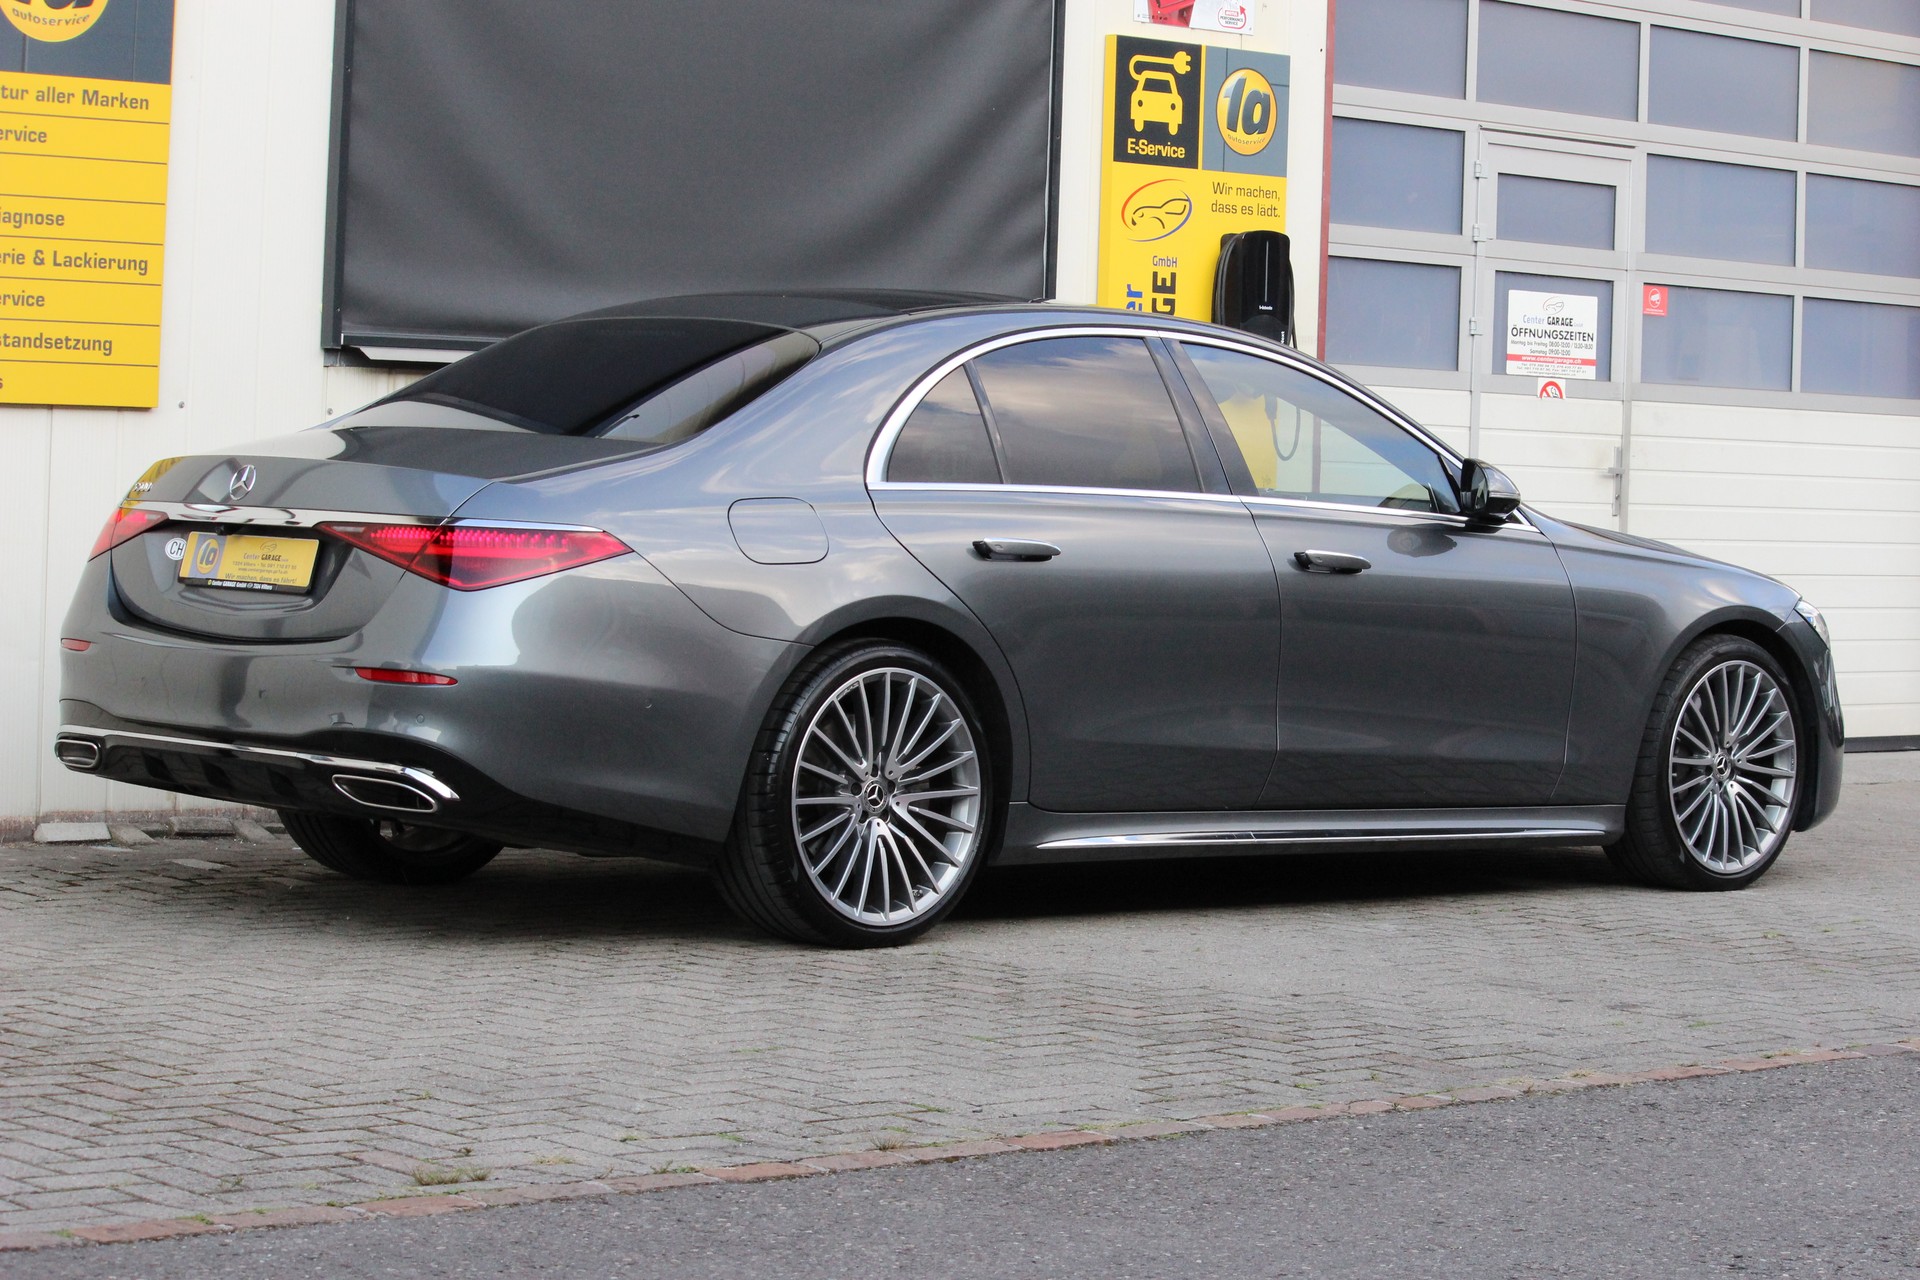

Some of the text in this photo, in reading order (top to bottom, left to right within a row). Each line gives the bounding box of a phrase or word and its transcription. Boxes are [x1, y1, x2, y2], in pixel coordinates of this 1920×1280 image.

[12, 7, 90, 26] autoservice
[1, 85, 149, 110] tur aller Marken
[1224, 74, 1271, 136] 1a
[1127, 137, 1186, 159] E-Service
[1227, 133, 1266, 145] autoservice
[1212, 181, 1281, 201] Wir machen,
[1211, 200, 1281, 218] dass es lädt.
[0, 248, 148, 276] rie & Lackierung
[1152, 255, 1178, 268] GmbH
[0, 290, 45, 307] rvice
[1522, 314, 1545, 325] Center
[1547, 316, 1573, 327] GARAGE
[1511, 324, 1594, 342] ÖFFNUNGSZEITEN
[0, 332, 113, 357] tandsetzung
[1534, 340, 1548, 348] Freitag
[170, 541, 185, 556] CH
[261, 553, 282, 562] GARAGE
